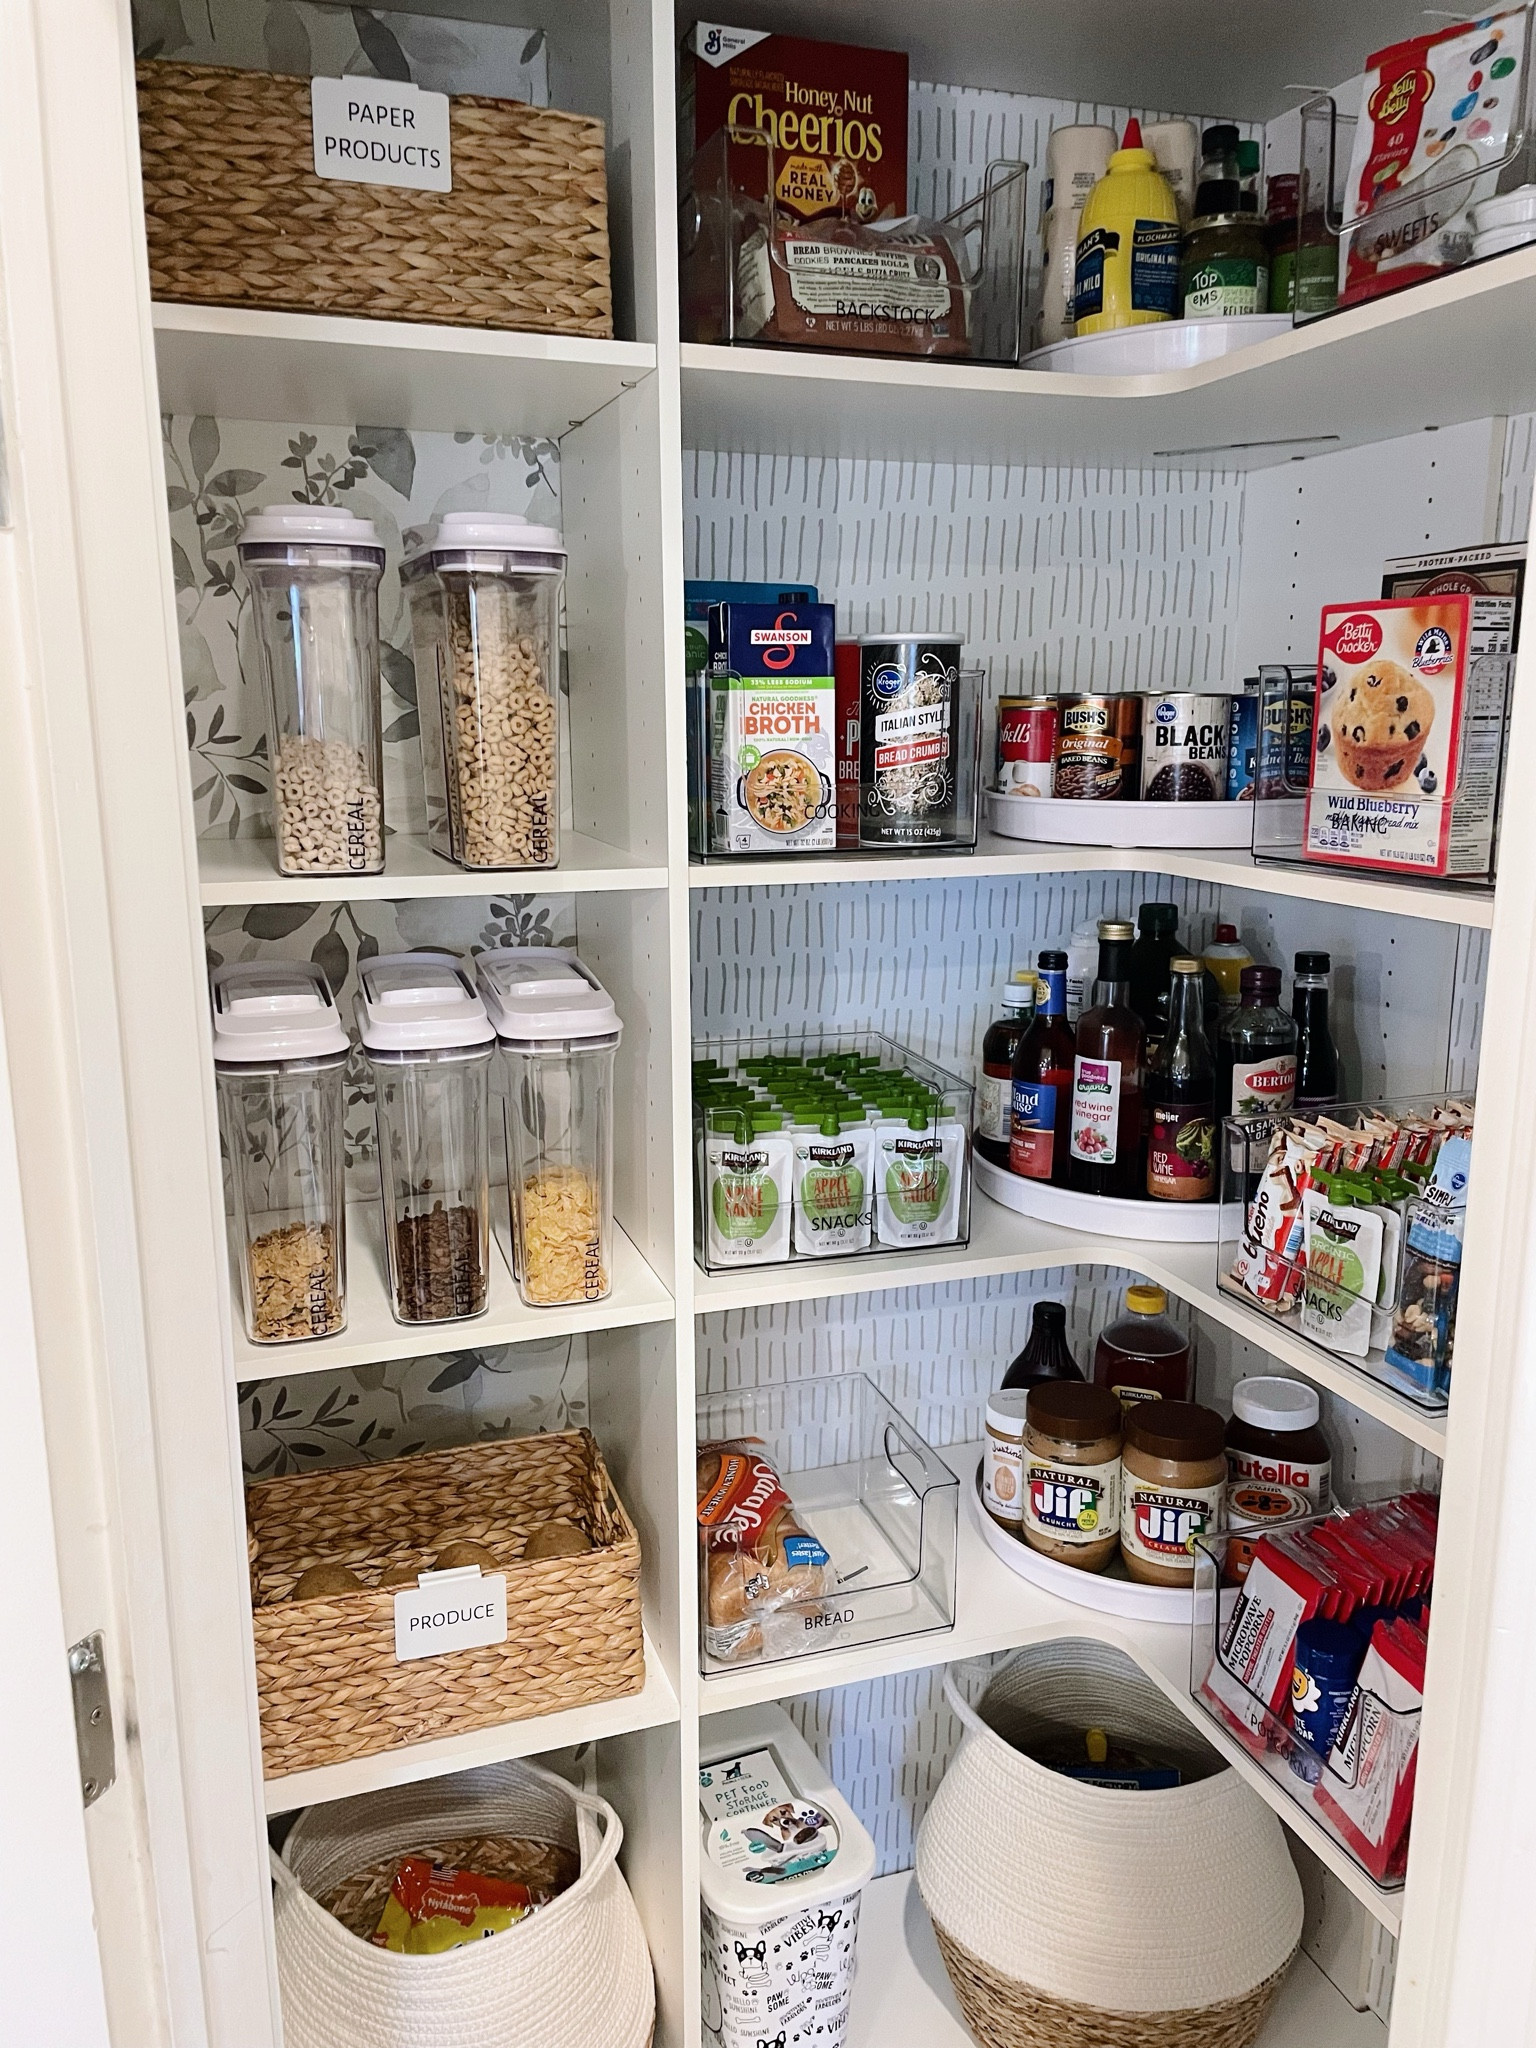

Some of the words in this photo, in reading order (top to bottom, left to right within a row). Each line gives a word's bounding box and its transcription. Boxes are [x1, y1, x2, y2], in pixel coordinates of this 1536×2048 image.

[785, 80, 838, 115] Honey
[843, 89, 873, 115] Nut
[1388, 78, 1417, 99] Jelly
[348, 101, 416, 129] PAPER
[1378, 96, 1410, 119] Belly
[728, 93, 883, 163] Cheerios
[1387, 133, 1404, 147] 40
[325, 136, 441, 169] PRODUCTS
[789, 171, 827, 187] REAL
[781, 184, 834, 202] HONEY
[1375, 212, 1440, 249] SWEETS
[793, 246, 820, 255] BREAD
[794, 257, 830, 265] COOKIES
[833, 257, 879, 266] PANCAKES
[881, 260, 910, 269] ROLLS
[1192, 270, 1218, 290] TOP
[836, 300, 937, 326] BACKSTOCK
[826, 320, 841, 331] NET
[1418, 552, 1492, 568] PROTEIN-PACKED
[1429, 582, 1459, 597] WHOLE
[754, 632, 808, 642] SWANSON
[1341, 622, 1374, 642] Betty
[1336, 636, 1378, 654] Crocker
[1412, 654, 1454, 668] Blueberries
[877, 675, 902, 691] Kroger
[749, 702, 816, 715] CHICKEN
[1157, 705, 1176, 721] Kroger
[745, 715, 821, 735] BROTH
[881, 715, 916, 733] ITALIAN
[1066, 710, 1106, 726] BUSH'S
[1062, 738, 1109, 750] Original
[1155, 725, 1225, 746] BLACK
[879, 751, 908, 765] BREAD
[1061, 756, 1082, 764] BAKED
[1082, 755, 1108, 765] BEANS
[1188, 746, 1227, 760] BEANS
[804, 803, 880, 820] COOKING
[1328, 796, 1355, 809] Wild
[1356, 797, 1420, 819] Blueberry
[533, 793, 548, 863] CEREAL
[881, 827, 893, 835] NET
[895, 828, 905, 836] WT
[906, 828, 913, 836] 15
[914, 828, 923, 836] OZ
[1331, 812, 1388, 834] BAKING
[1403, 818, 1419, 829] mix
[347, 798, 366, 870] CEREAL
[1078, 1083, 1110, 1095] organic
[1075, 1099, 1087, 1109] red
[1088, 1102, 1113, 1112] wine
[1075, 1109, 1111, 1122] vinegar
[1155, 1112, 1180, 1123] meijer
[1255, 1130, 1267, 1140] OF
[725, 1151, 768, 1162] KIRKLAND
[812, 1145, 853, 1156] KIRKLAND
[1153, 1151, 1168, 1164] RED
[809, 1167, 856, 1178] ORGANIC
[1153, 1161, 1174, 1176] WINE
[814, 1174, 850, 1194] APPLE
[811, 1212, 873, 1232] SNACKS
[1242, 1191, 1269, 1260] bueno
[585, 1237, 600, 1300] CEREAL
[455, 1250, 471, 1316] CEREAL
[309, 1268, 327, 1336] CEREAL
[1292, 1282, 1343, 1322] SNACKS
[722, 1458, 740, 1487] HONEY
[1034, 1469, 1093, 1487] NATURAL
[1228, 1456, 1310, 1487] nutella
[741, 1462, 786, 1509] Sara
[701, 1486, 728, 1518] WHEAT
[1034, 1482, 1093, 1519] Jif
[1139, 1492, 1202, 1509] NATURAL
[712, 1504, 762, 1545] Lee
[1041, 1515, 1076, 1528] CRUNCHY
[1139, 1506, 1201, 1544] Jif
[1148, 1541, 1184, 1553] CREAMY
[409, 1603, 495, 1632] PRODUCE
[804, 1609, 855, 1630] BREAD
[1221, 1595, 1245, 1650] KIRKLAND
[1228, 1595, 1262, 1671] MICROWAVE
[1238, 1611, 1266, 1670] POPCORN
[1335, 1685, 1360, 1746] KIRKLAND
[715, 1789, 737, 1803] PET
[741, 1780, 769, 1795] FOOD
[726, 1791, 769, 1810] STORAGE
[726, 1798, 778, 1818] CONTAINER
[428, 1897, 471, 1915] Nylabone
[767, 1990, 784, 2005] PAW
[768, 1996, 790, 2013] SOME
